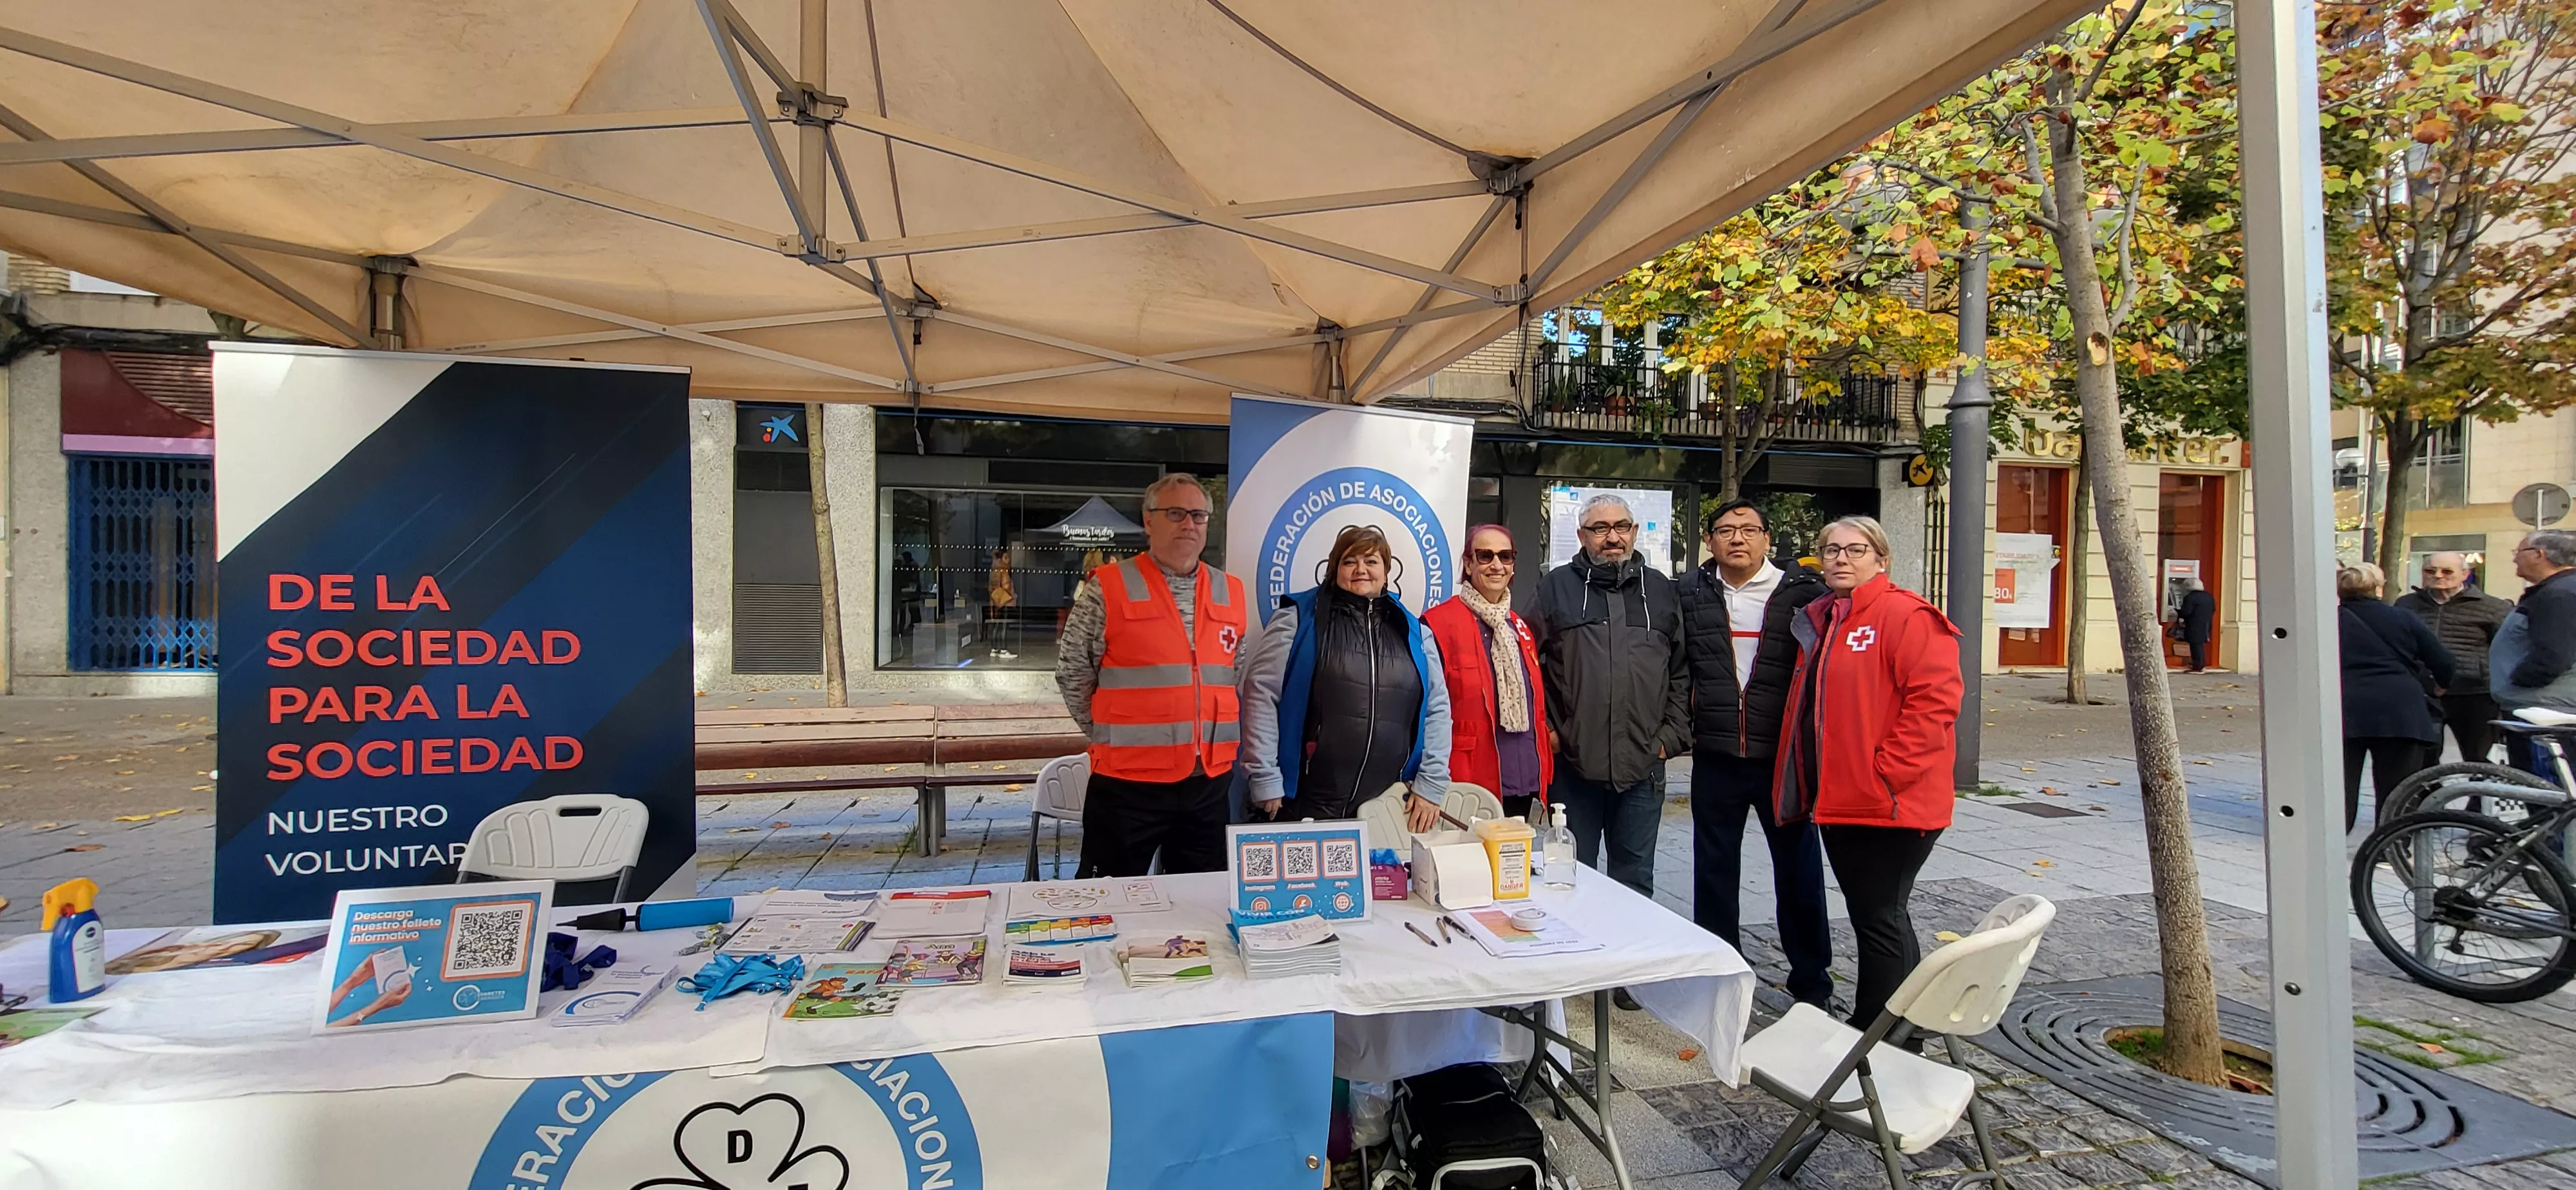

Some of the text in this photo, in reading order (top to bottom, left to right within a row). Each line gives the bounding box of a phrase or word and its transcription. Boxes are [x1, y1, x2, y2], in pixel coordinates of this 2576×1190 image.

[1339, 481, 1366, 500] DE
[1369, 484, 1443, 609] ASOCIACIONES
[268, 574, 450, 611] DE LA
[267, 630, 582, 667] SOCIEDAD
[269, 684, 529, 724] PARA LA
[267, 736, 584, 780] SOCIEDAD
[267, 804, 448, 835] NUESTRO
[352, 918, 442, 931] nuestro folleto
[354, 909, 414, 921] Descarga
[350, 930, 419, 943] informativo
[727, 1129, 753, 1164] D
